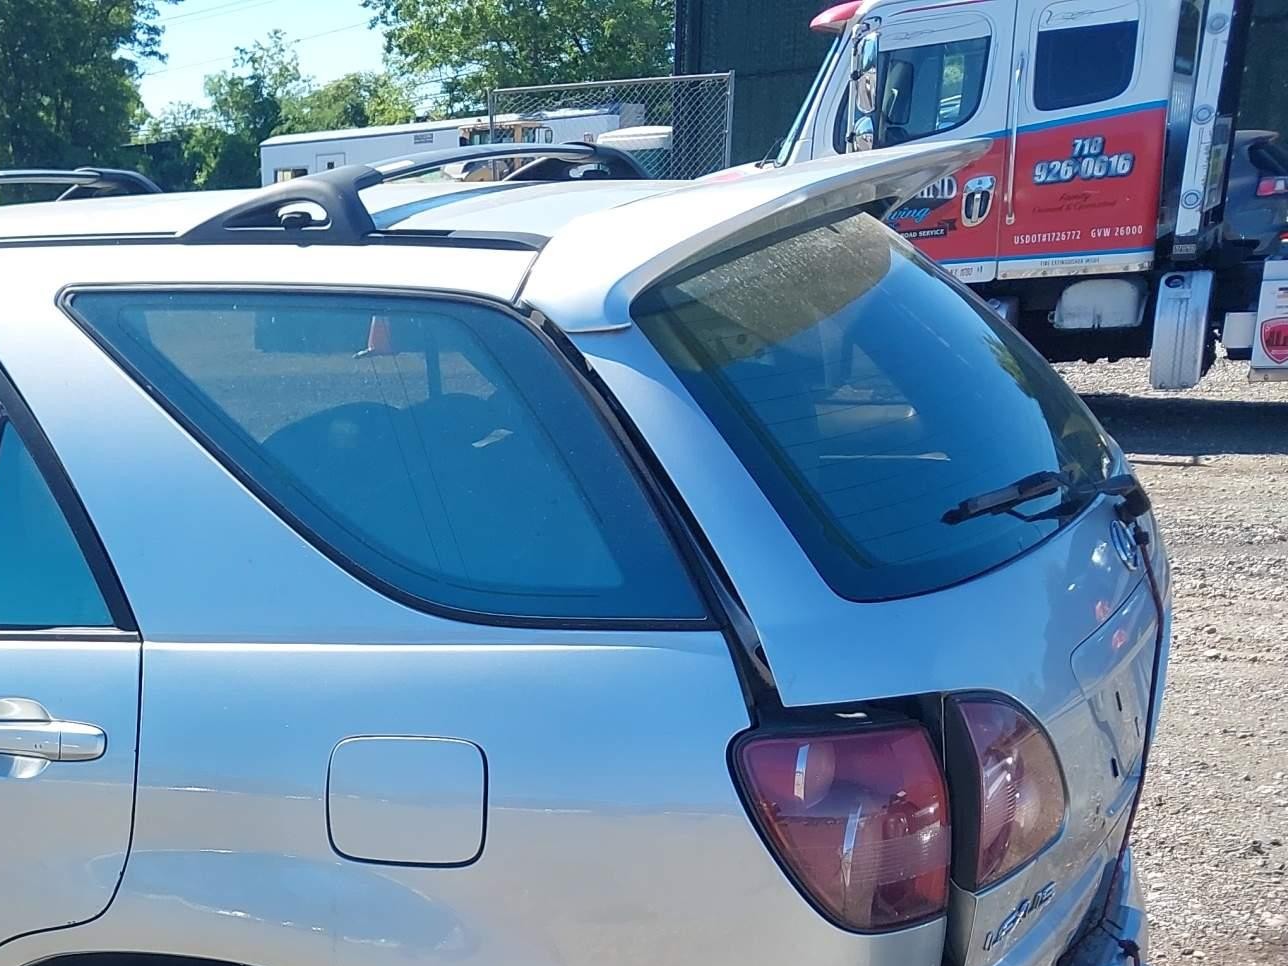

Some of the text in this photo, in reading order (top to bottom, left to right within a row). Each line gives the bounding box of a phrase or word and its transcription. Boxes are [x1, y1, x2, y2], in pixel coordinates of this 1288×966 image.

[1072, 136, 1104, 156] 718
[887, 207, 930, 224] wing
[1014, 225, 1143, 245] USDOT#1726772 GVW 26000
